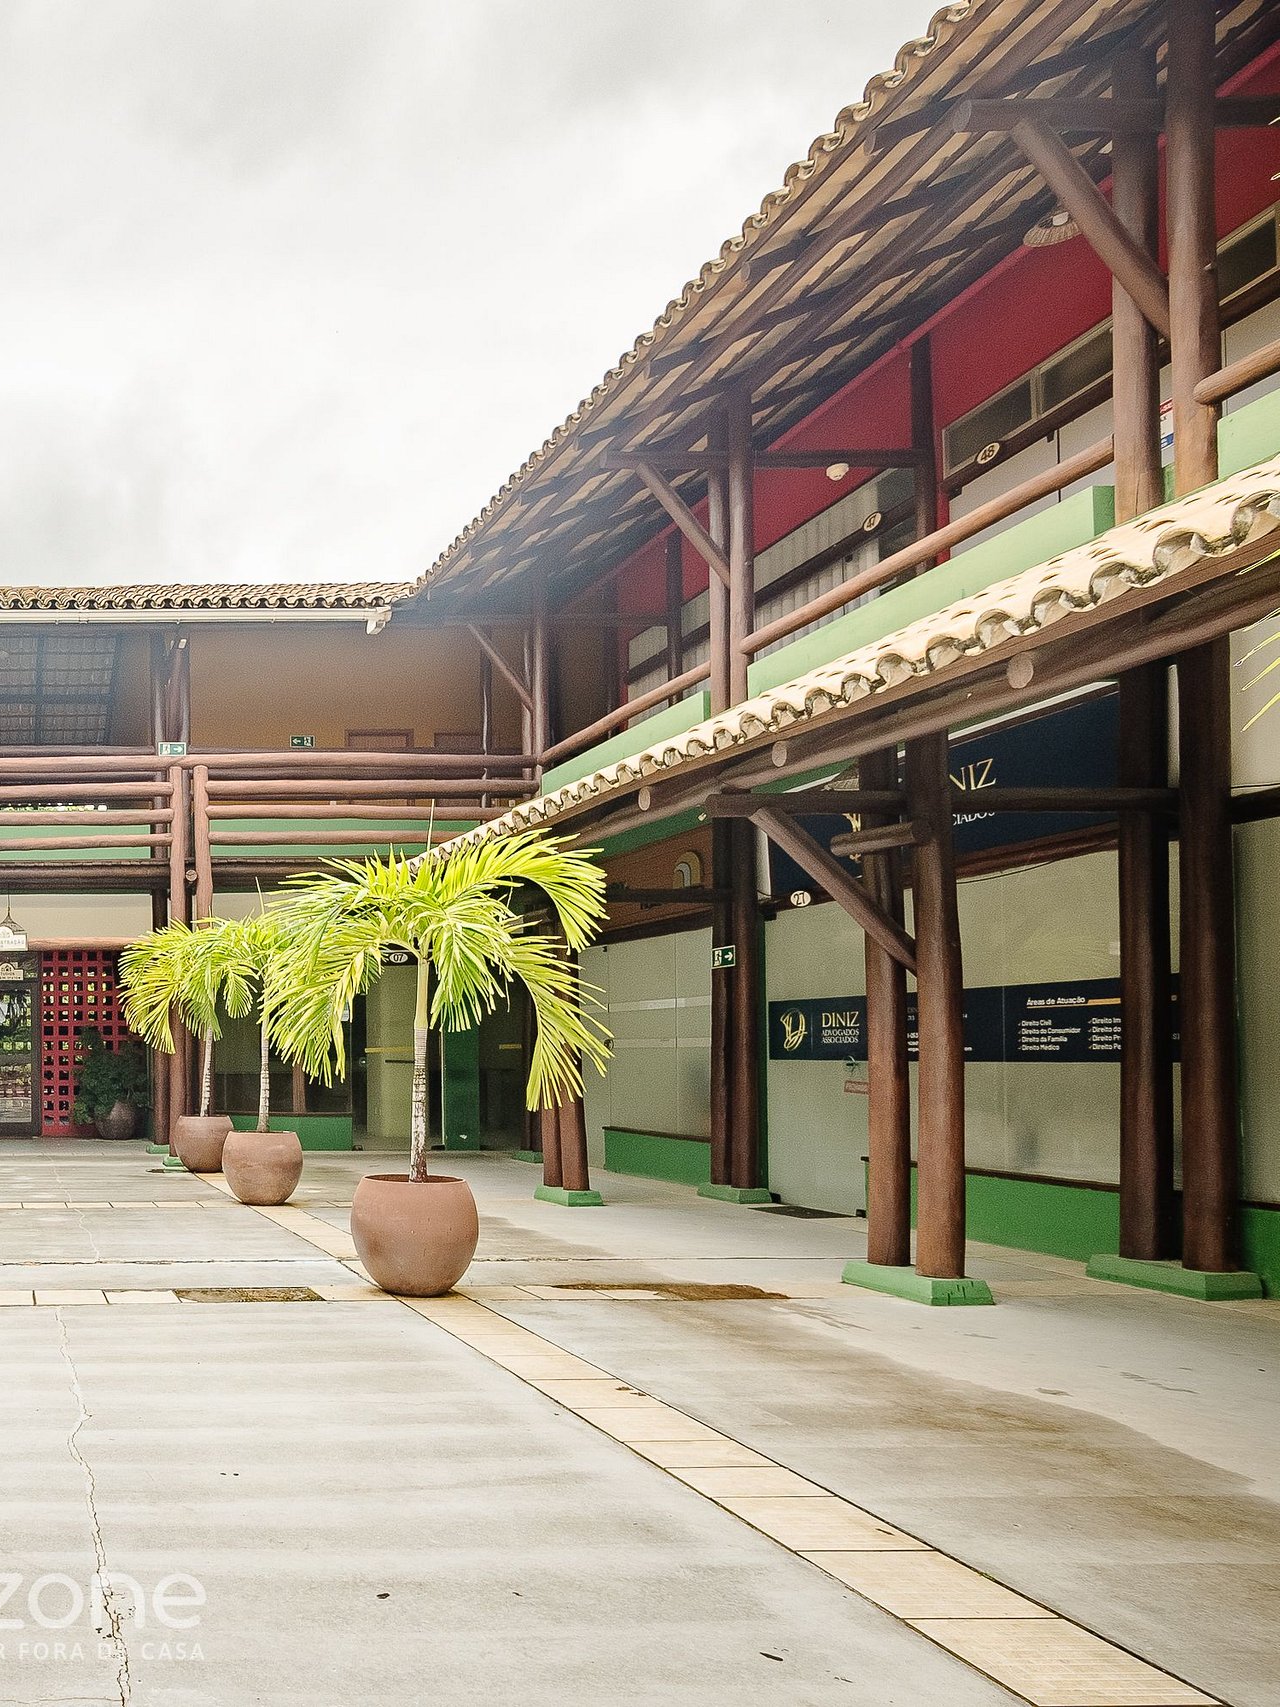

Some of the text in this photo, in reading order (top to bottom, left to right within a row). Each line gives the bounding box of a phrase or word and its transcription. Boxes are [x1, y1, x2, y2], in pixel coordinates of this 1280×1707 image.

[980, 445, 995, 461] 48
[866, 514, 877, 528] 47
[793, 892, 806, 906] 27
[393, 953, 404, 962] 07
[1026, 997, 1046, 1006] Áreas
[1056, 996, 1086, 1004] Atuação
[821, 1011, 860, 1028] DINIZ
[821, 1028, 860, 1036] ADVOGADOS
